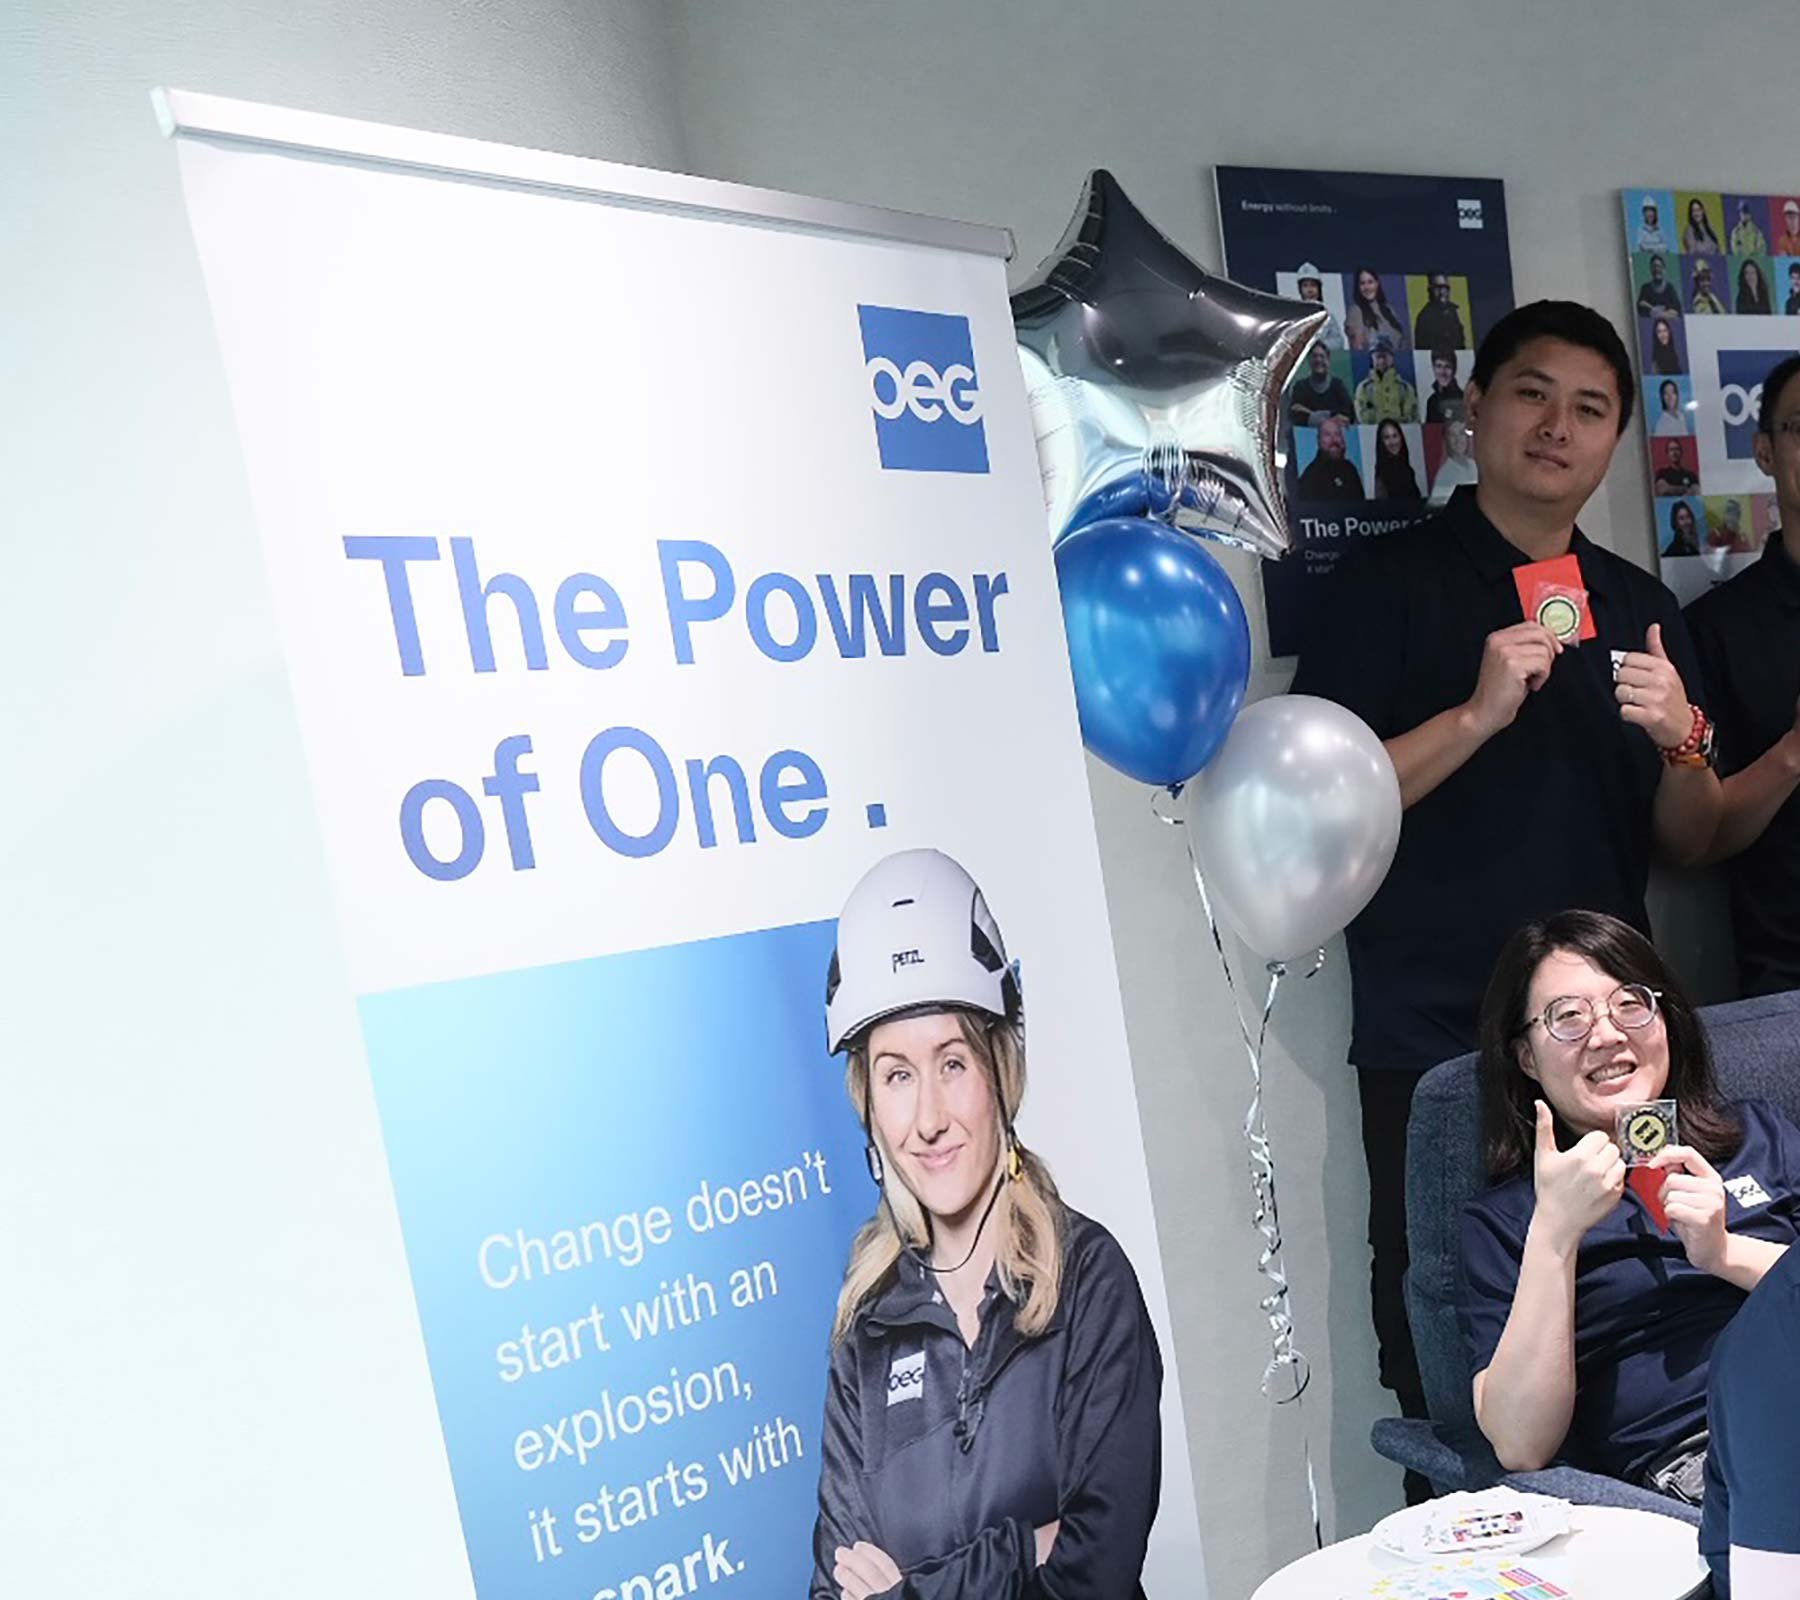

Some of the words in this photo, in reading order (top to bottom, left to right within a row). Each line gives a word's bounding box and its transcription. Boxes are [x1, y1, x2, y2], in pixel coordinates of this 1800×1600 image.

[1300, 517, 1340, 538] The
[343, 535, 628, 676] The
[656, 539, 1011, 666] Power
[400, 735, 541, 882] of
[580, 725, 829, 858] One
[478, 1206, 672, 1289] Change
[496, 1304, 611, 1382] start
[620, 1273, 718, 1341] with
[729, 1261, 778, 1308] an
[514, 1362, 753, 1471] explosion,
[528, 1507, 563, 1563] it
[574, 1460, 708, 1543] starts
[718, 1416, 804, 1486] with
